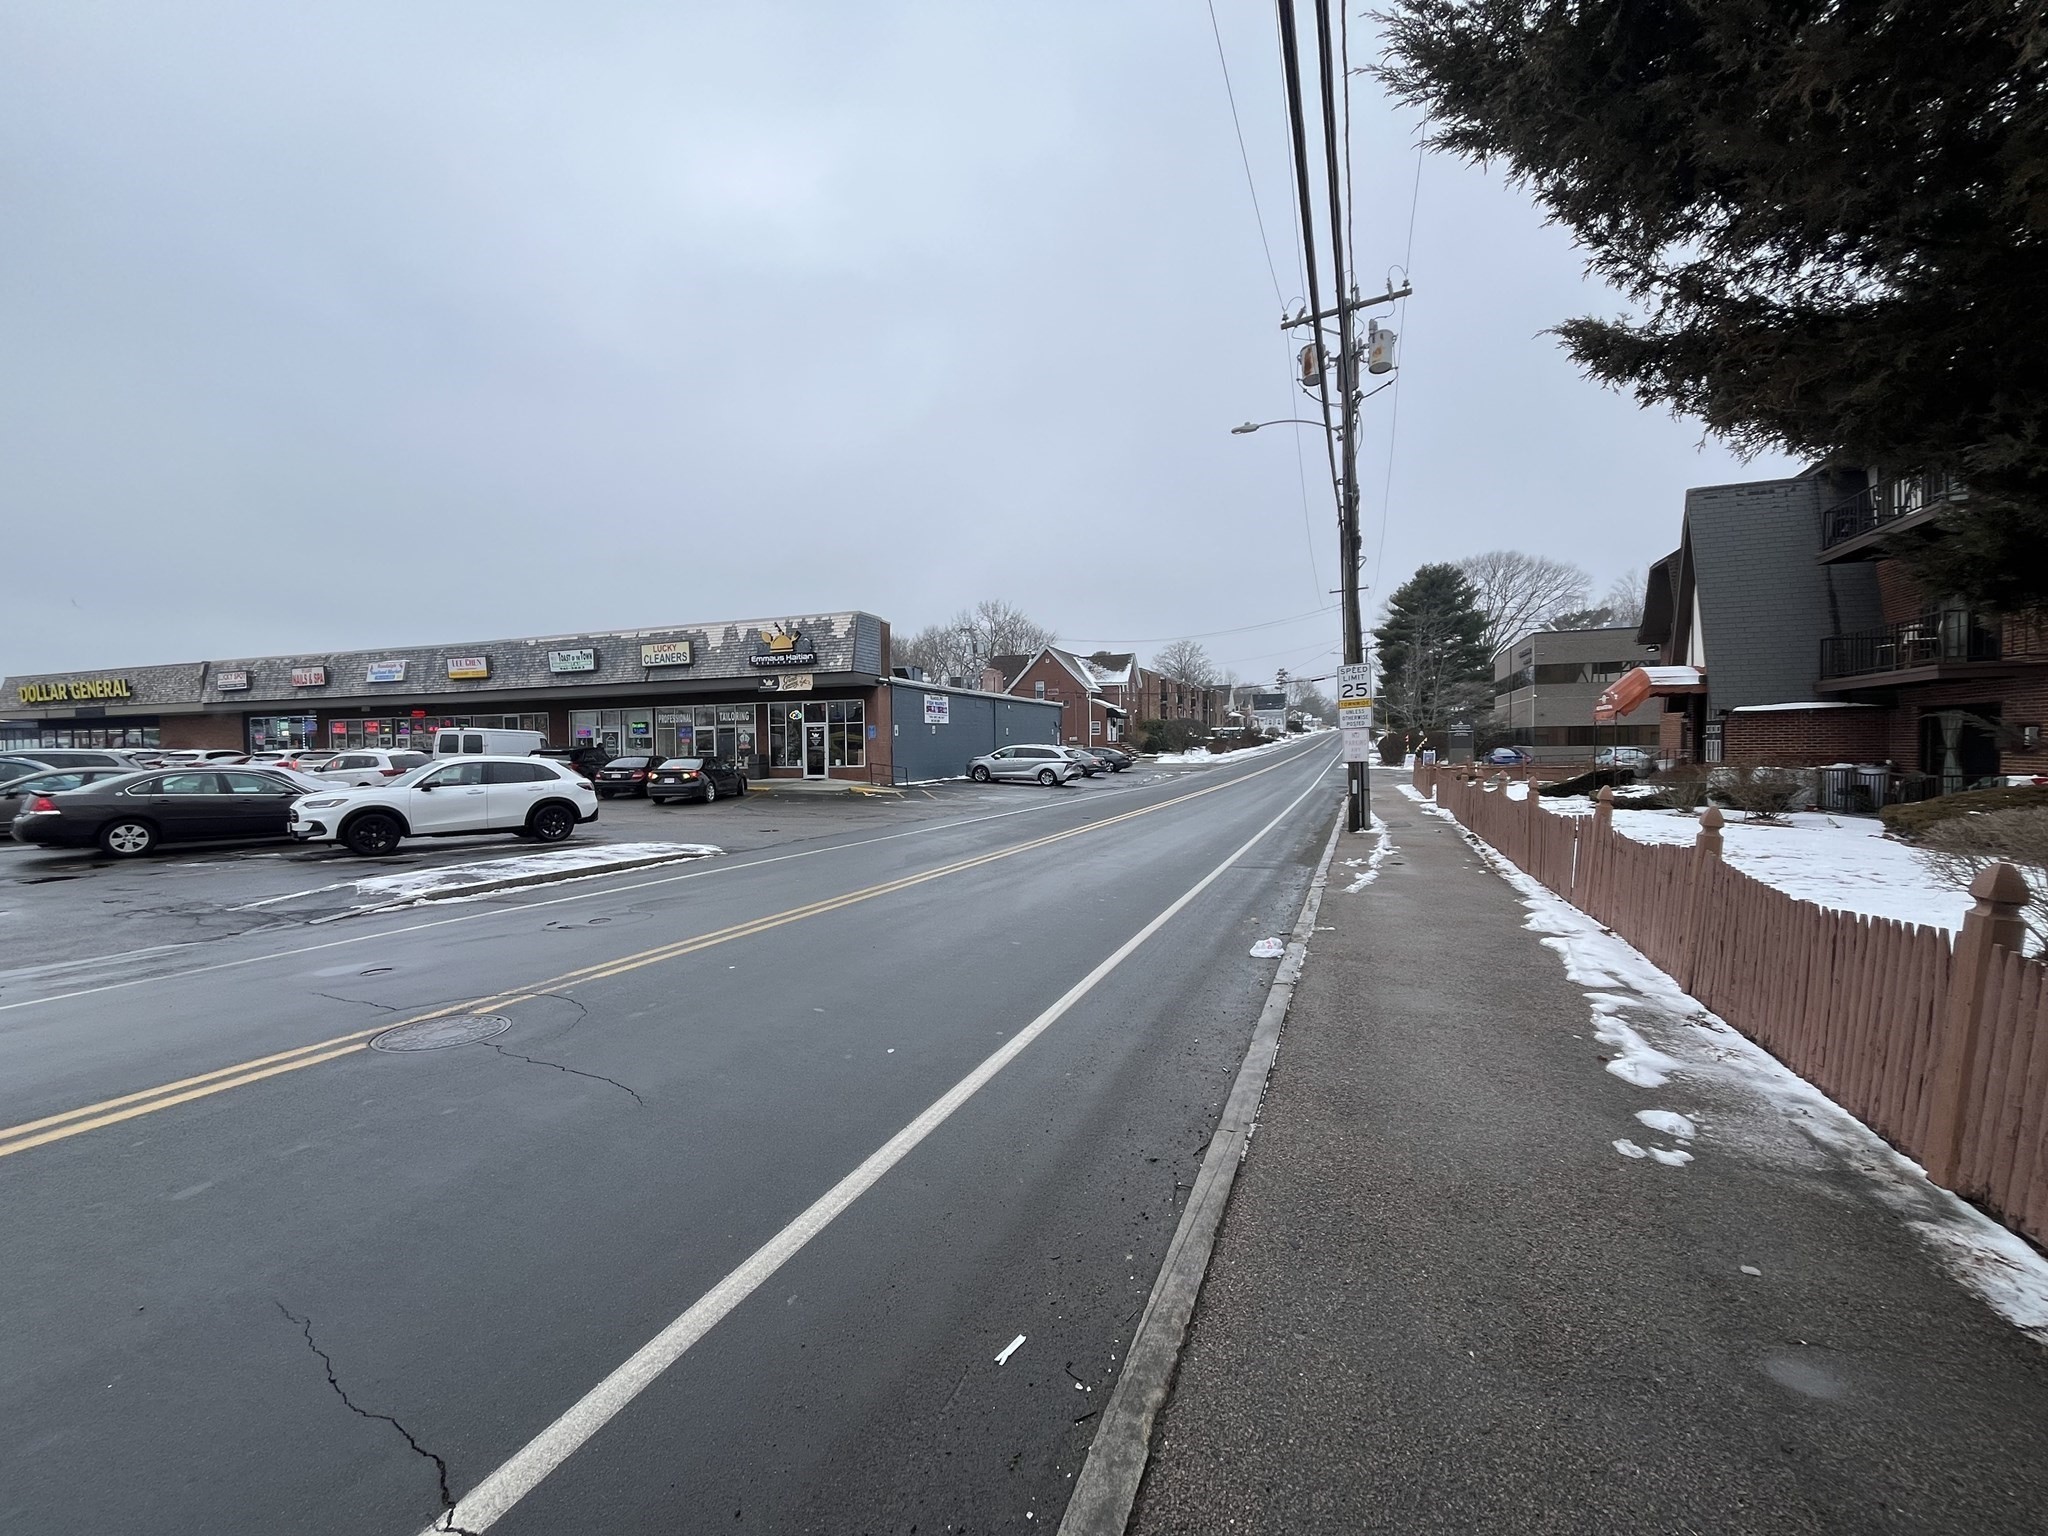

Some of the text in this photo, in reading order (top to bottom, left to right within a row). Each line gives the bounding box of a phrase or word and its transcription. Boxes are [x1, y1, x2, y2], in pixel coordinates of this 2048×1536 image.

[653, 644, 677, 653] LUCKY
[557, 652, 571, 662] TOAST
[580, 650, 592, 660] TOWN
[644, 652, 688, 665] CLEANERS
[751, 653, 814, 663] Emmaus Haitian
[1340, 666, 1368, 674] SPEED
[292, 672, 324, 685] NAILS & SPA
[18, 679, 131, 703] DOLLAR GENERAL
[1342, 682, 1368, 698] 25
[658, 711, 750, 723] PROFESSIONAL TAILORING
